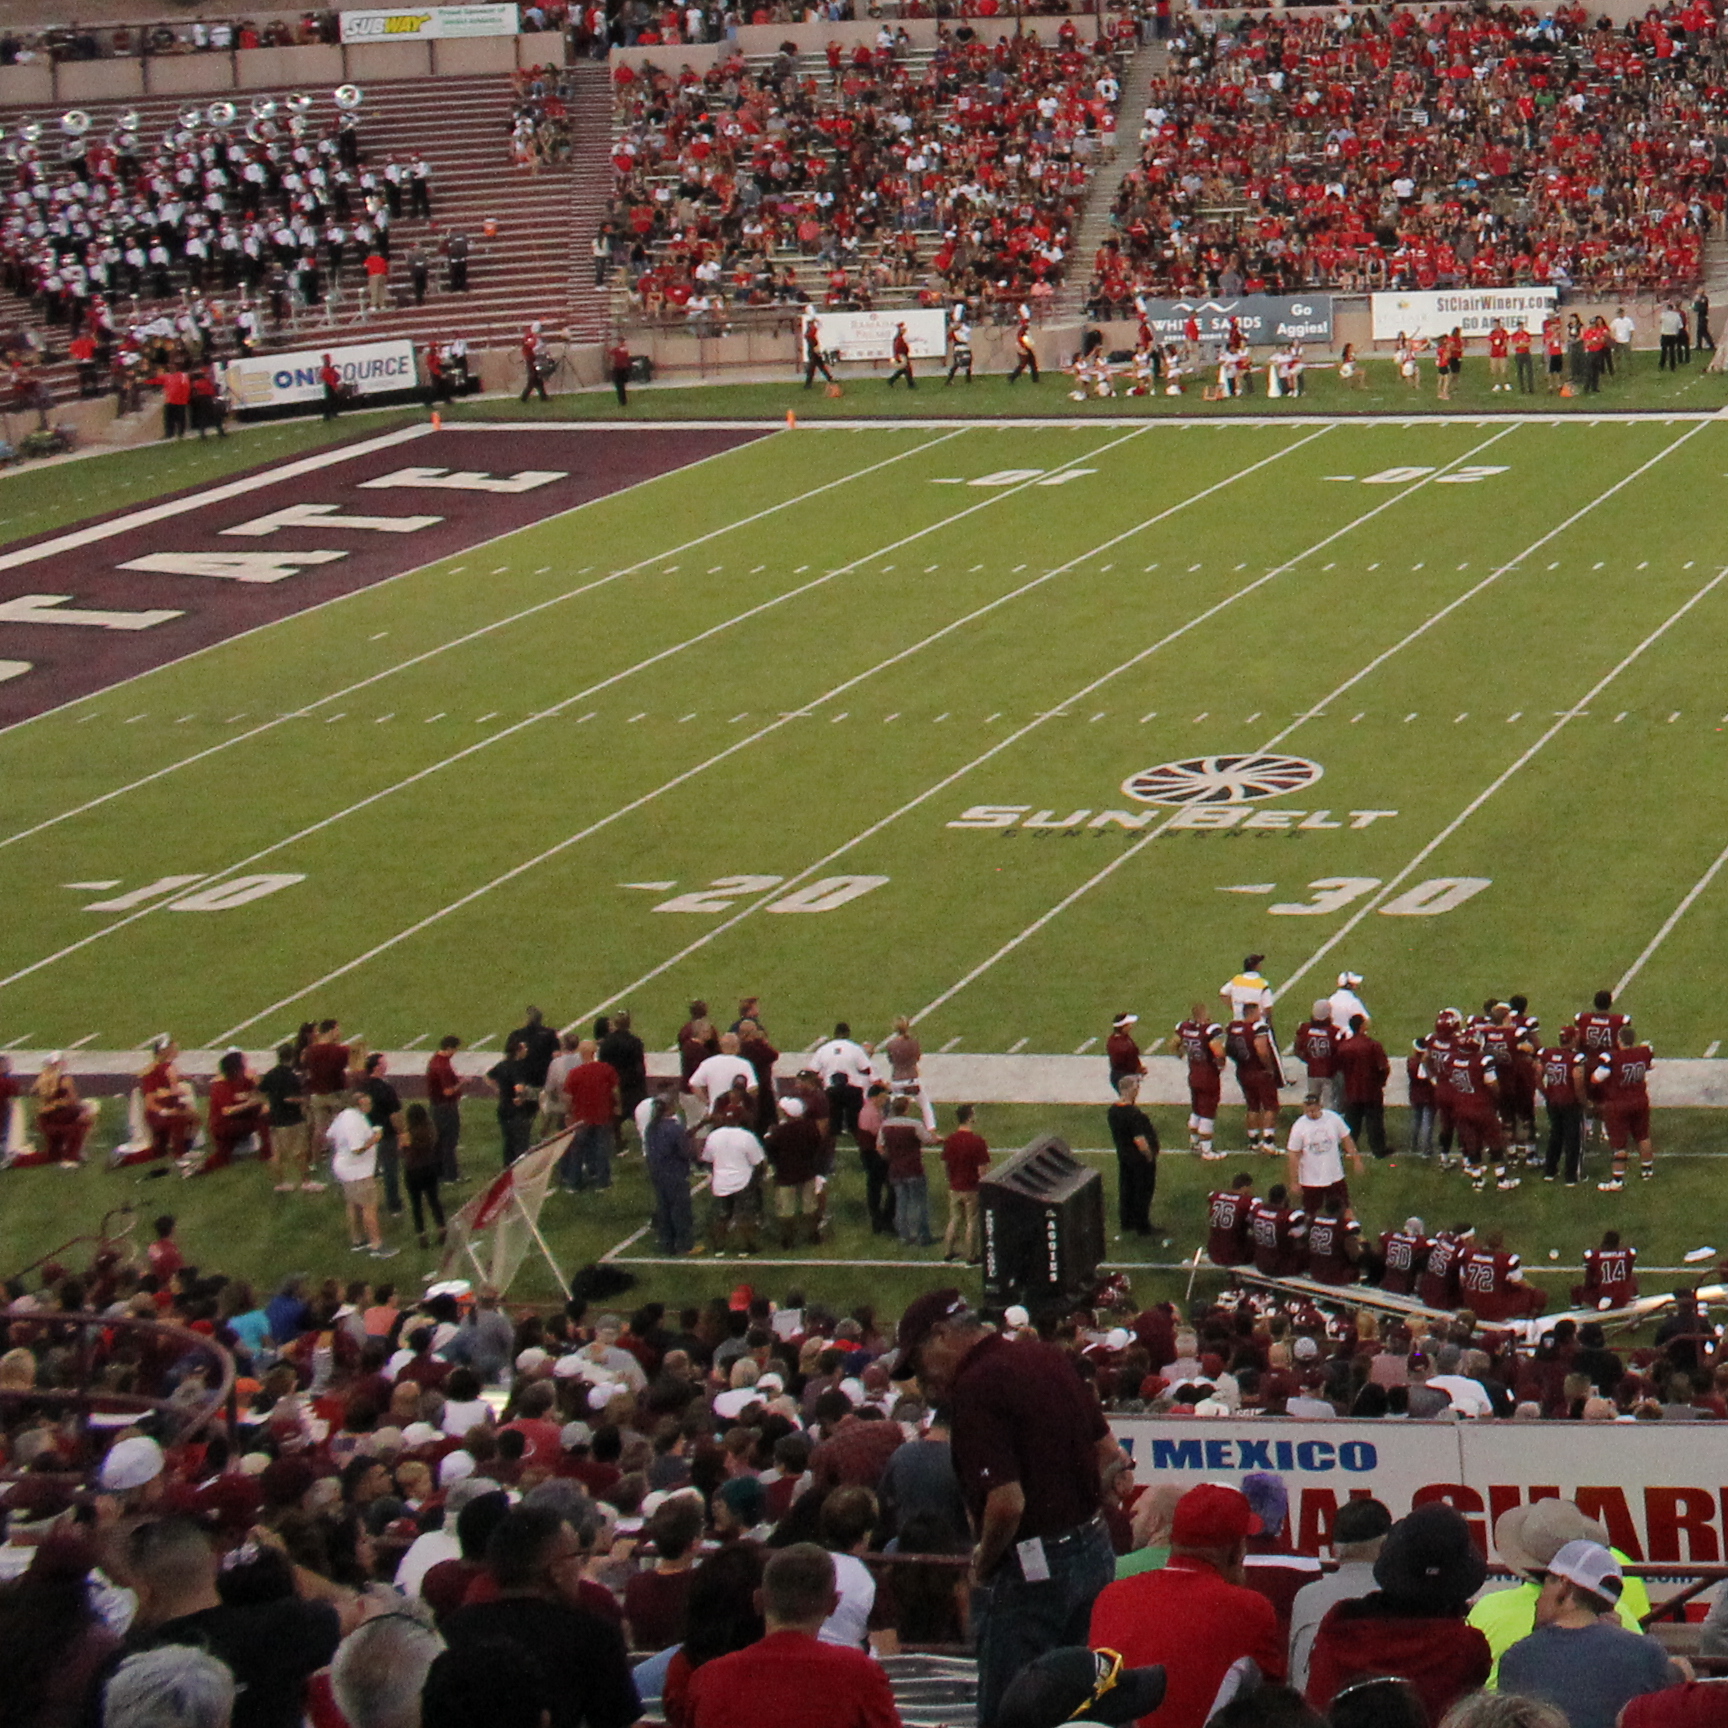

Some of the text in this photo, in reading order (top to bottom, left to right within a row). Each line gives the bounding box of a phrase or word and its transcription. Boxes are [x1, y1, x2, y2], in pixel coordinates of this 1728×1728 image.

[345, 14, 432, 37] SUBWAY
[1290, 303, 1313, 317] Go
[1152, 317, 1203, 332] WHIE
[1276, 321, 1328, 338] Aggies!
[1462, 315, 1479, 330] GO
[966, 468, 1099, 486] 10
[1360, 465, 1511, 484] 20
[0, 466, 569, 674] TATE
[945, 805, 1399, 830] SUN BELT
[82, 874, 306, 913] 10
[651, 874, 890, 913] 20
[1266, 876, 1494, 916] 30
[1151, 1438, 1378, 1472] MEXICO
